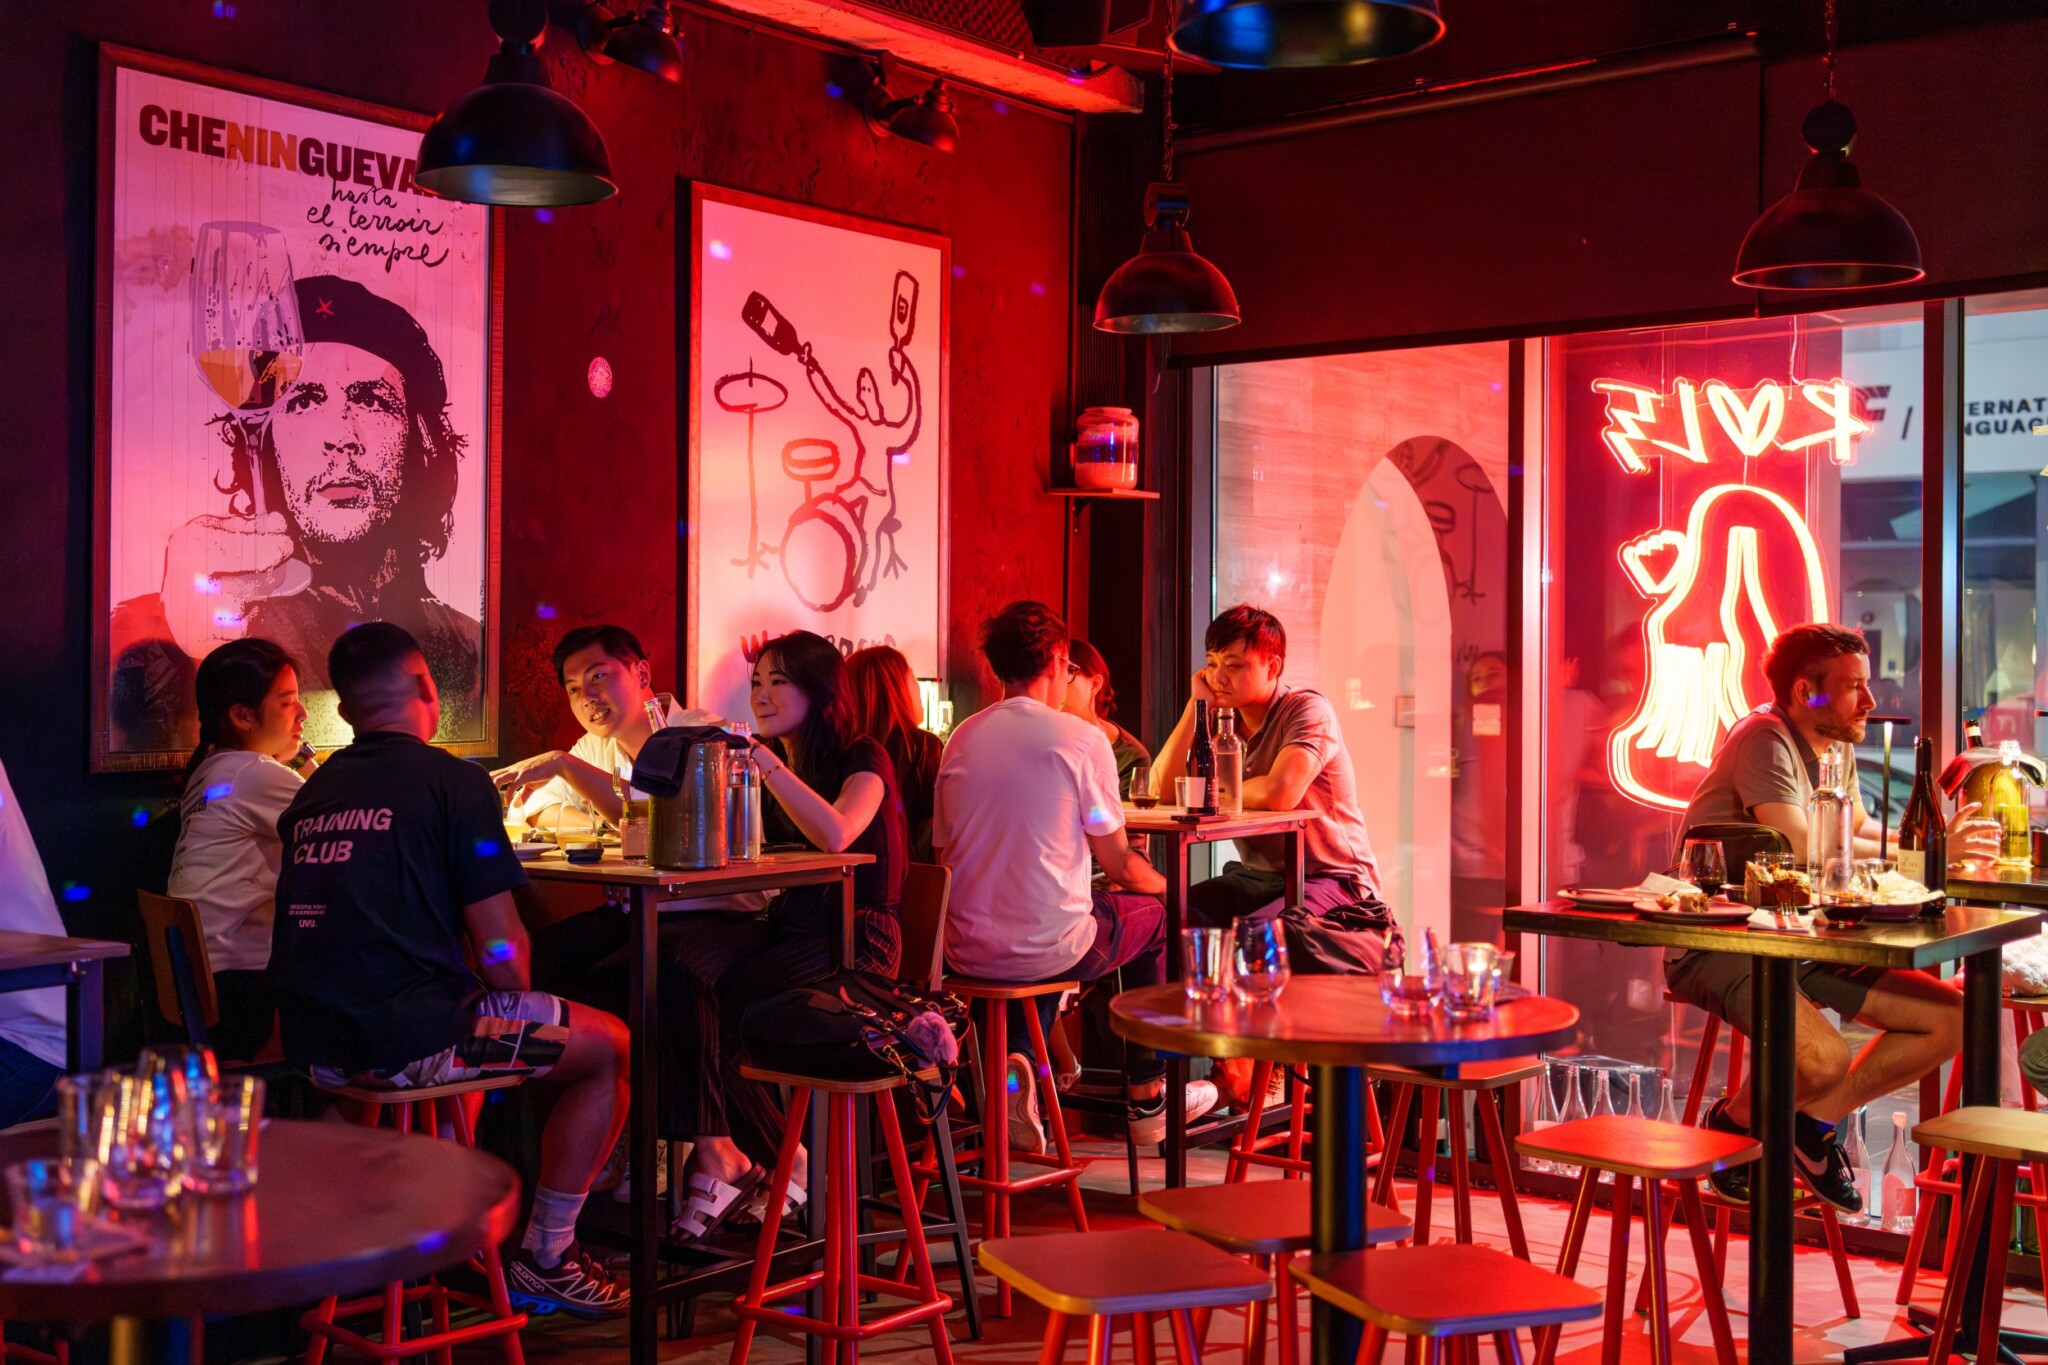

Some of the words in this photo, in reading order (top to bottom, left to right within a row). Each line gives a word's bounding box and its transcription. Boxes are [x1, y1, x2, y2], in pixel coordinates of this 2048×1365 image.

[139, 104, 471, 205] CHENINGUEVA
[331, 174, 398, 208] hasta
[306, 204, 334, 227] el
[348, 206, 444, 235] terroir
[318, 229, 449, 273] siempre
[293, 807, 394, 843] TRAINING
[293, 840, 354, 865] CLUB
